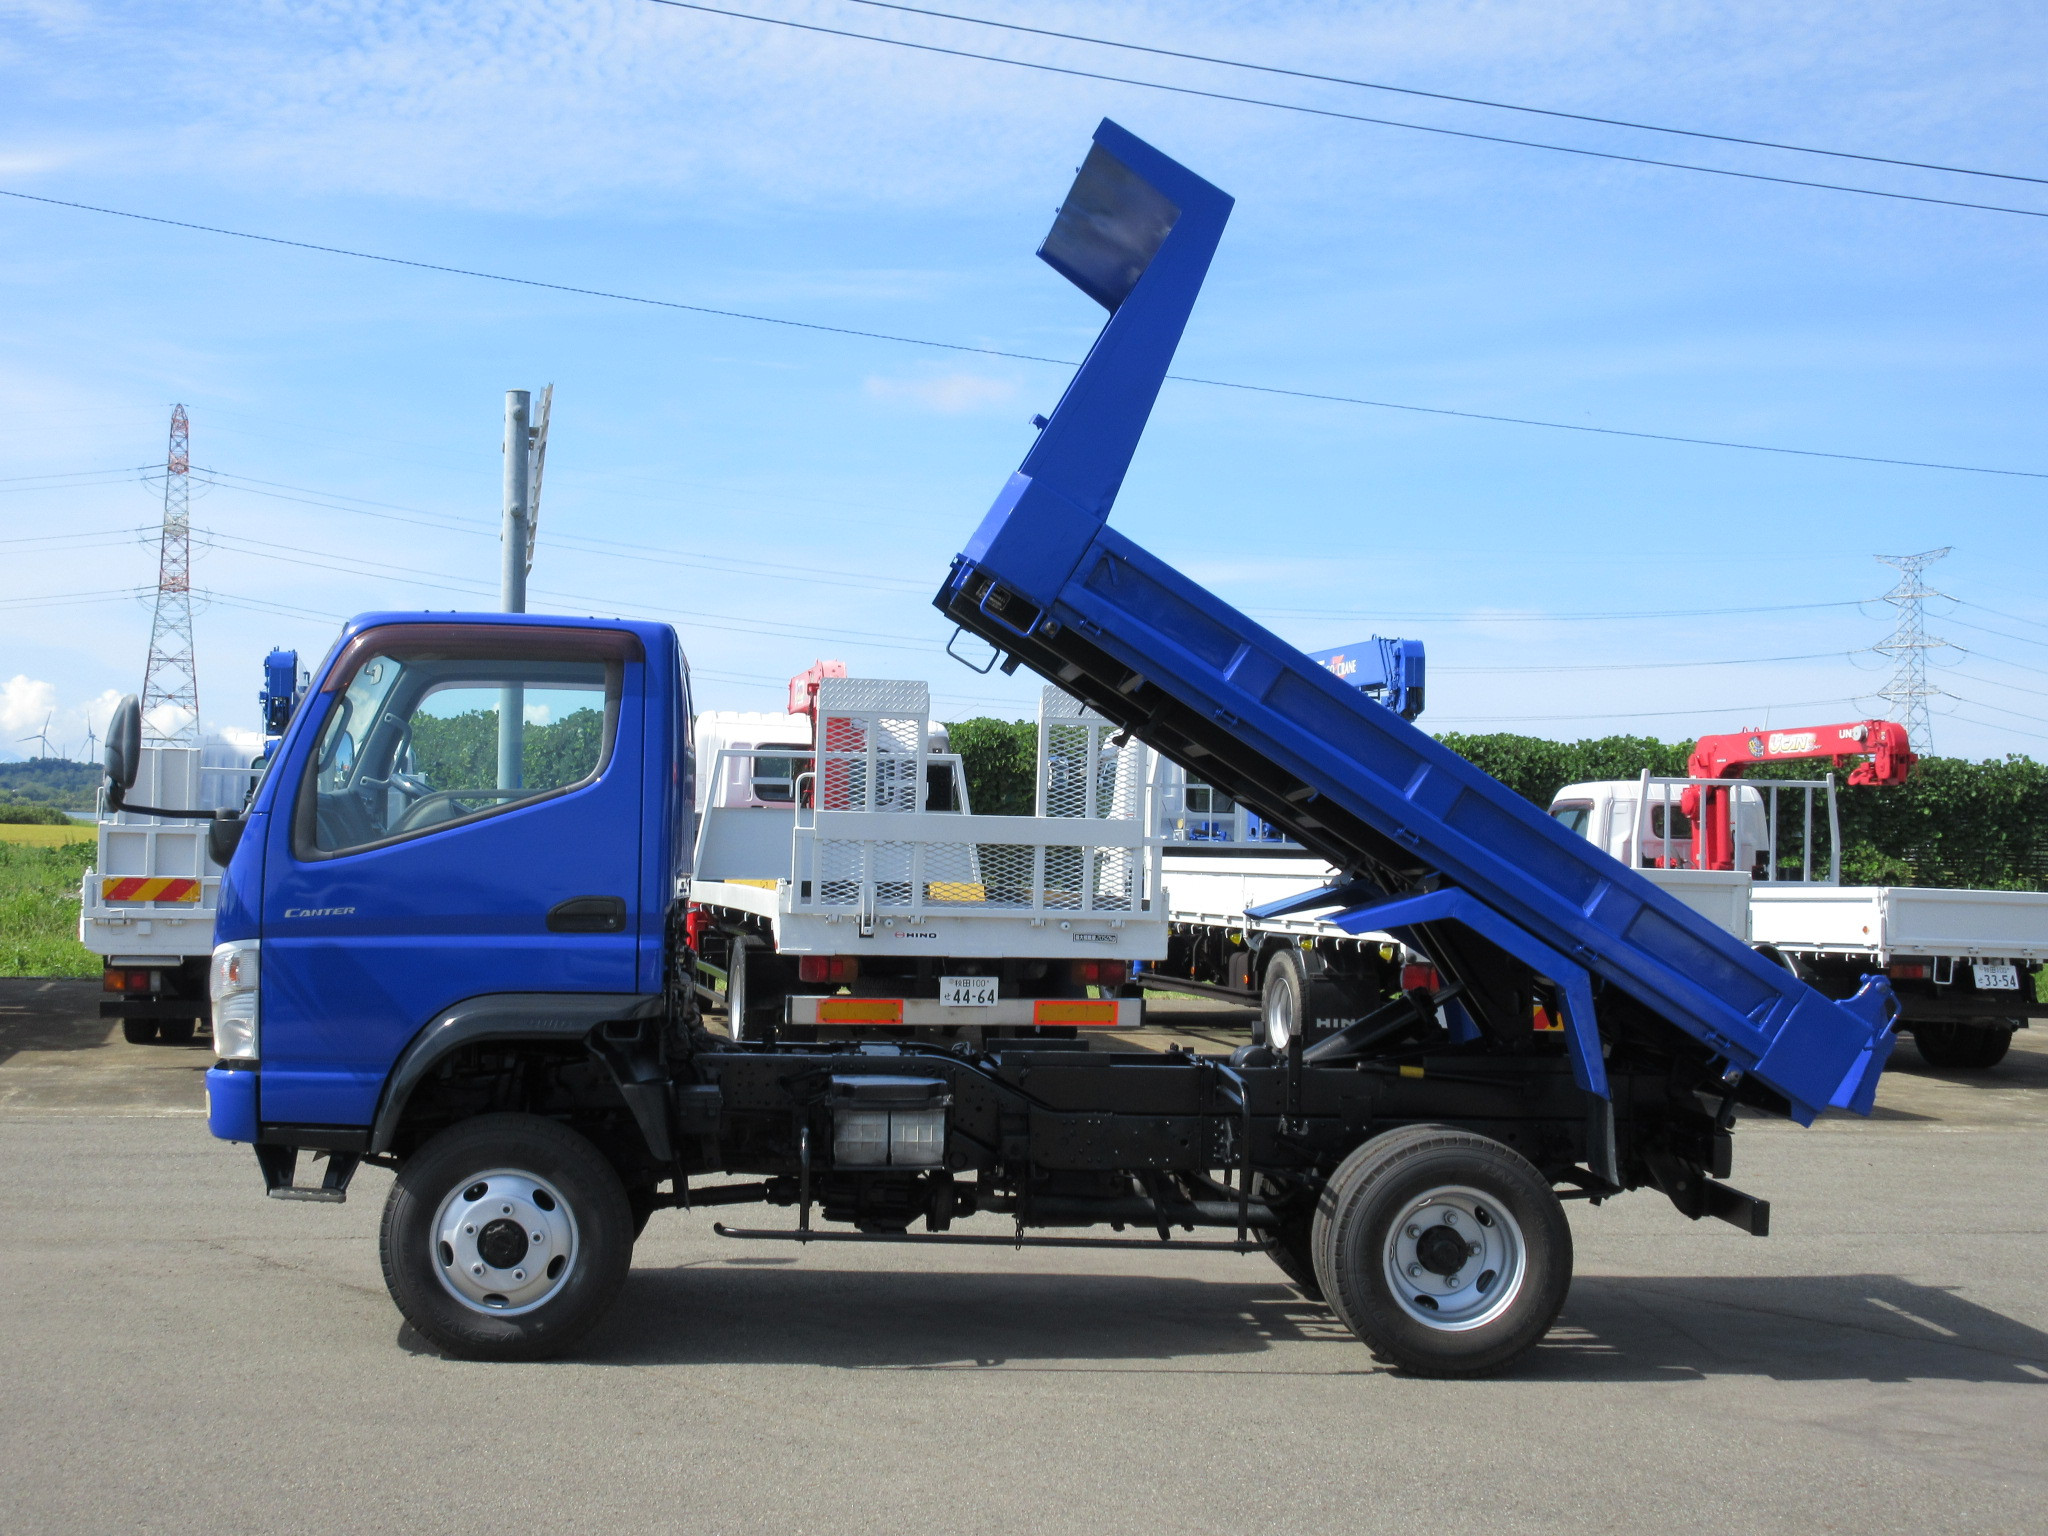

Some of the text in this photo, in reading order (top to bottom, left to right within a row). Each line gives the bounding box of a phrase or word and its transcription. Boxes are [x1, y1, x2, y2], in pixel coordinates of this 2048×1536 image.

[284, 907, 356, 918] CANTER
[1984, 974, 2016, 987] 33-54
[953, 989, 995, 1004] 44-64
[1316, 1018, 1356, 1028] HIN
